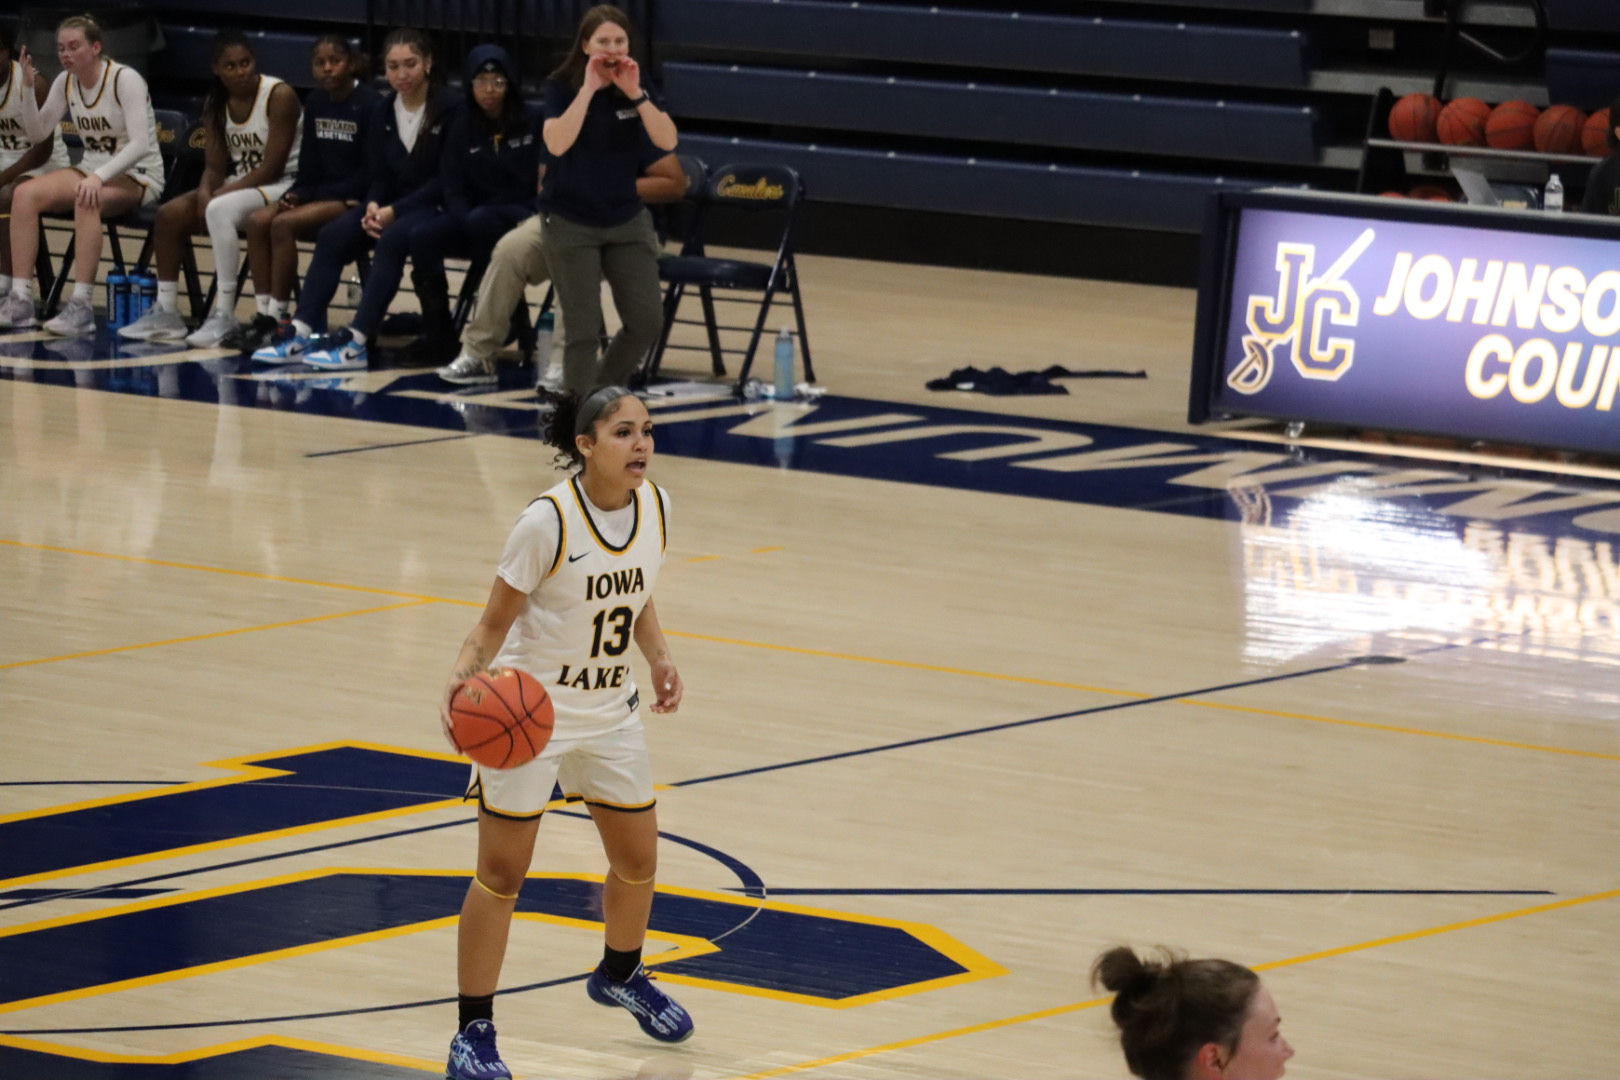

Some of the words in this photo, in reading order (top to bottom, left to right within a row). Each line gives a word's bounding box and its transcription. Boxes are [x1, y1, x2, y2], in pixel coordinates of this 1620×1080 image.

[0, 117, 22, 131] WA
[76, 116, 112, 131] IOWA
[226, 132, 263, 149] IOWA
[586, 567, 645, 601] IOWA
[589, 605, 633, 659] 13
[555, 664, 630, 691] LAKE
